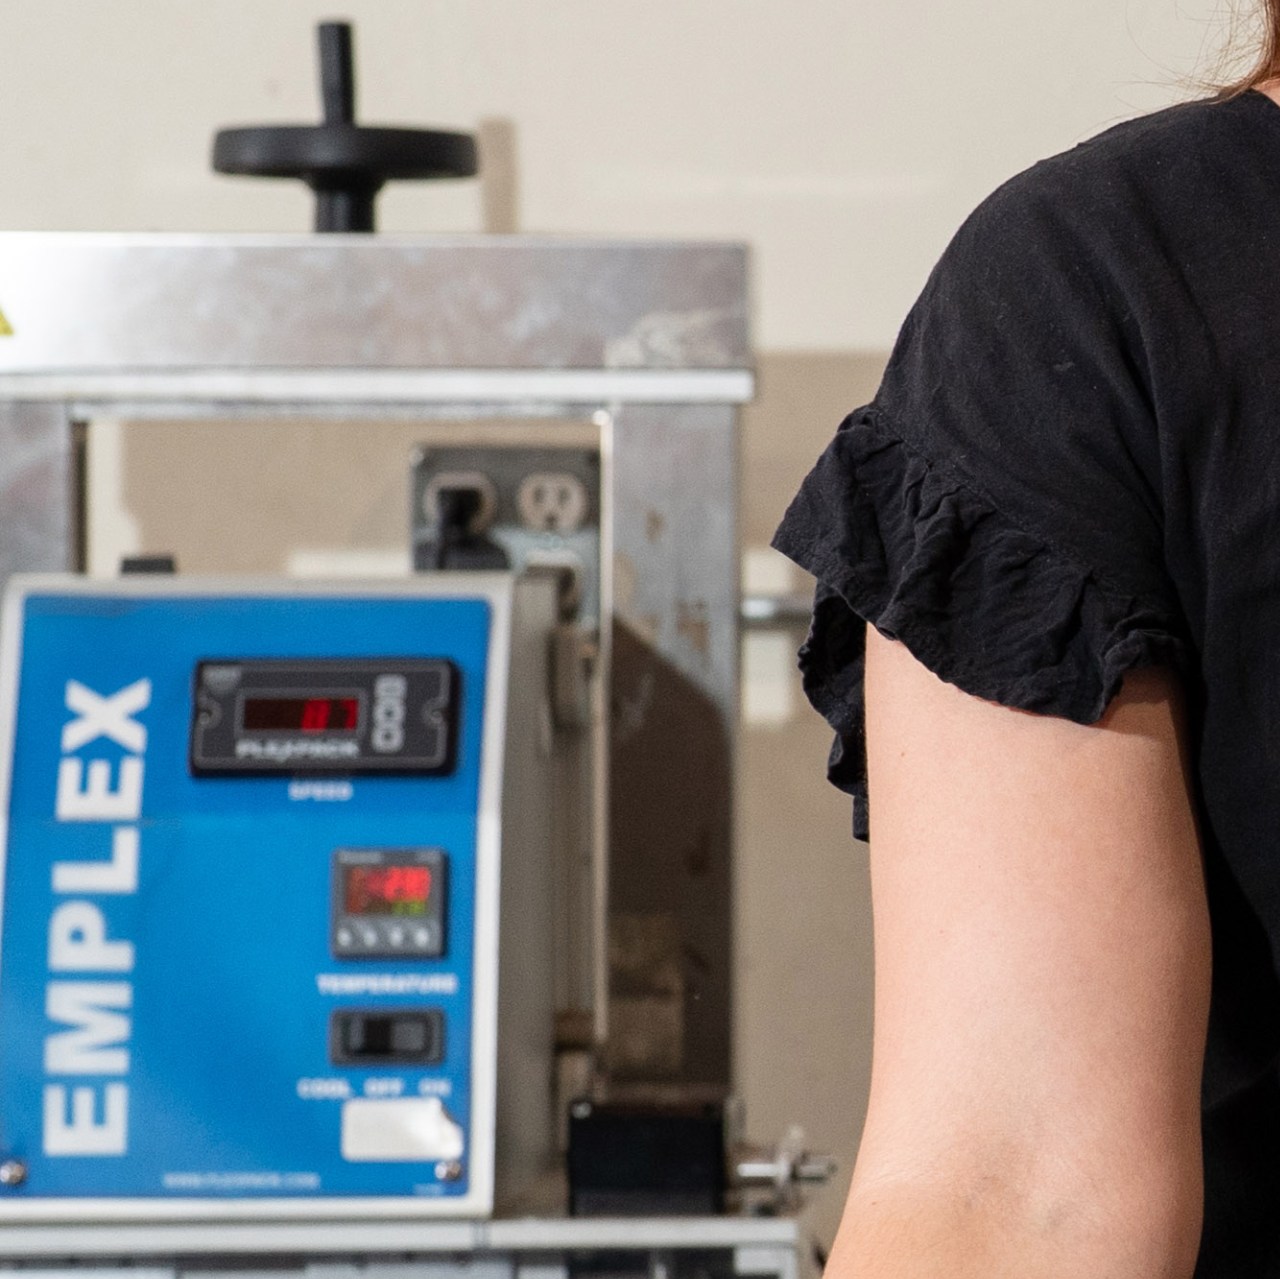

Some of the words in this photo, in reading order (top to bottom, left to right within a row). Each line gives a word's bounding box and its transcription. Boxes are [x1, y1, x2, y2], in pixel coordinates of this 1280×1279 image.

[288, 780, 355, 801] SPEED
[43, 677, 152, 1157] EMPLEX
[317, 974, 458, 995] TEMPERATURE
[364, 1078, 404, 1097] OFF
